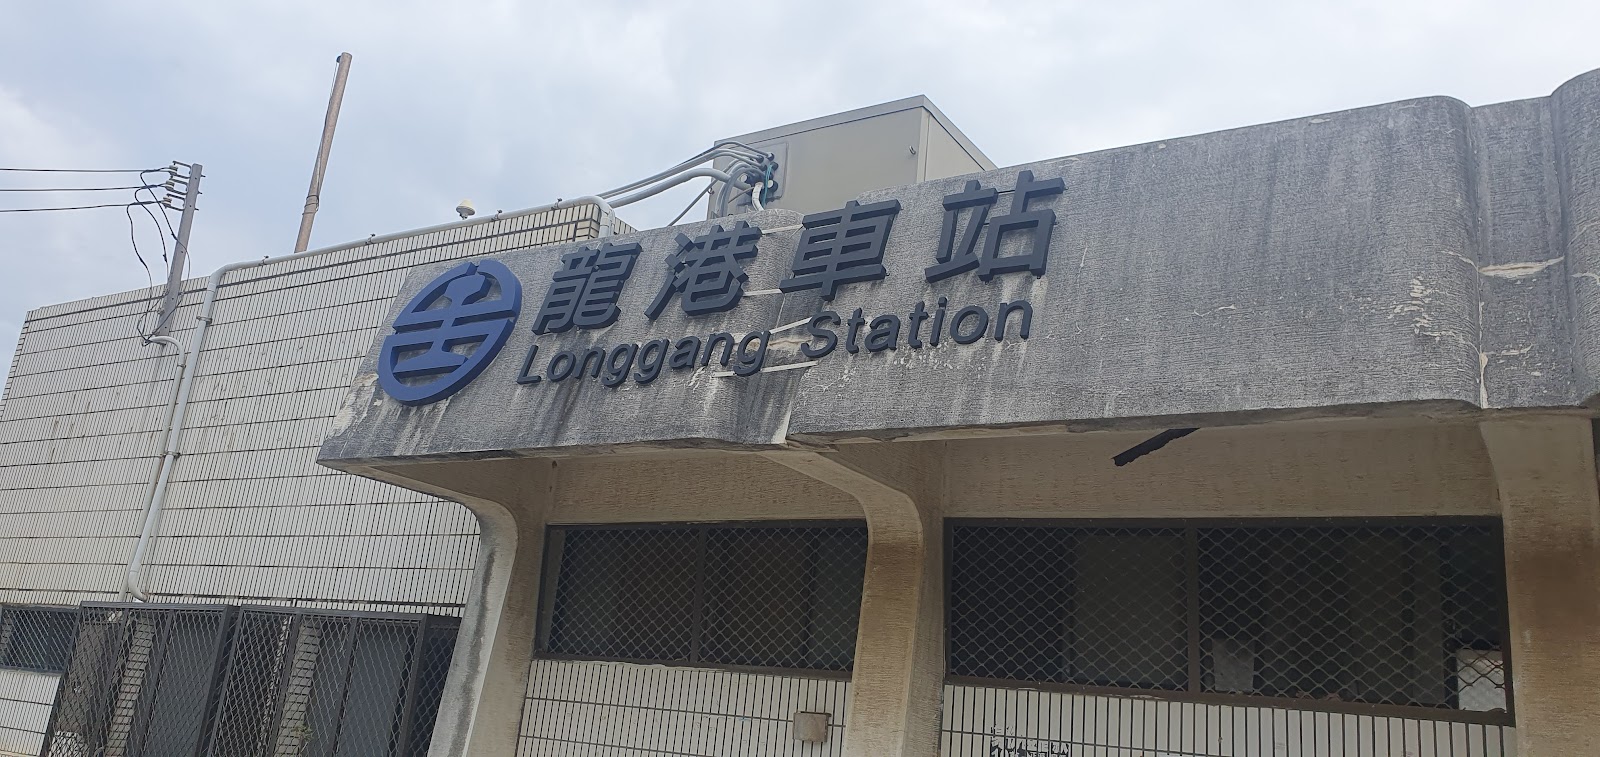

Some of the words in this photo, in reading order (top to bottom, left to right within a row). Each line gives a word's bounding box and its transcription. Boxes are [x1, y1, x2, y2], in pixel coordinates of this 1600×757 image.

[531, 171, 1065, 335] 龍港車站
[515, 326, 770, 387] Longgang
[803, 297, 1033, 359] Station
